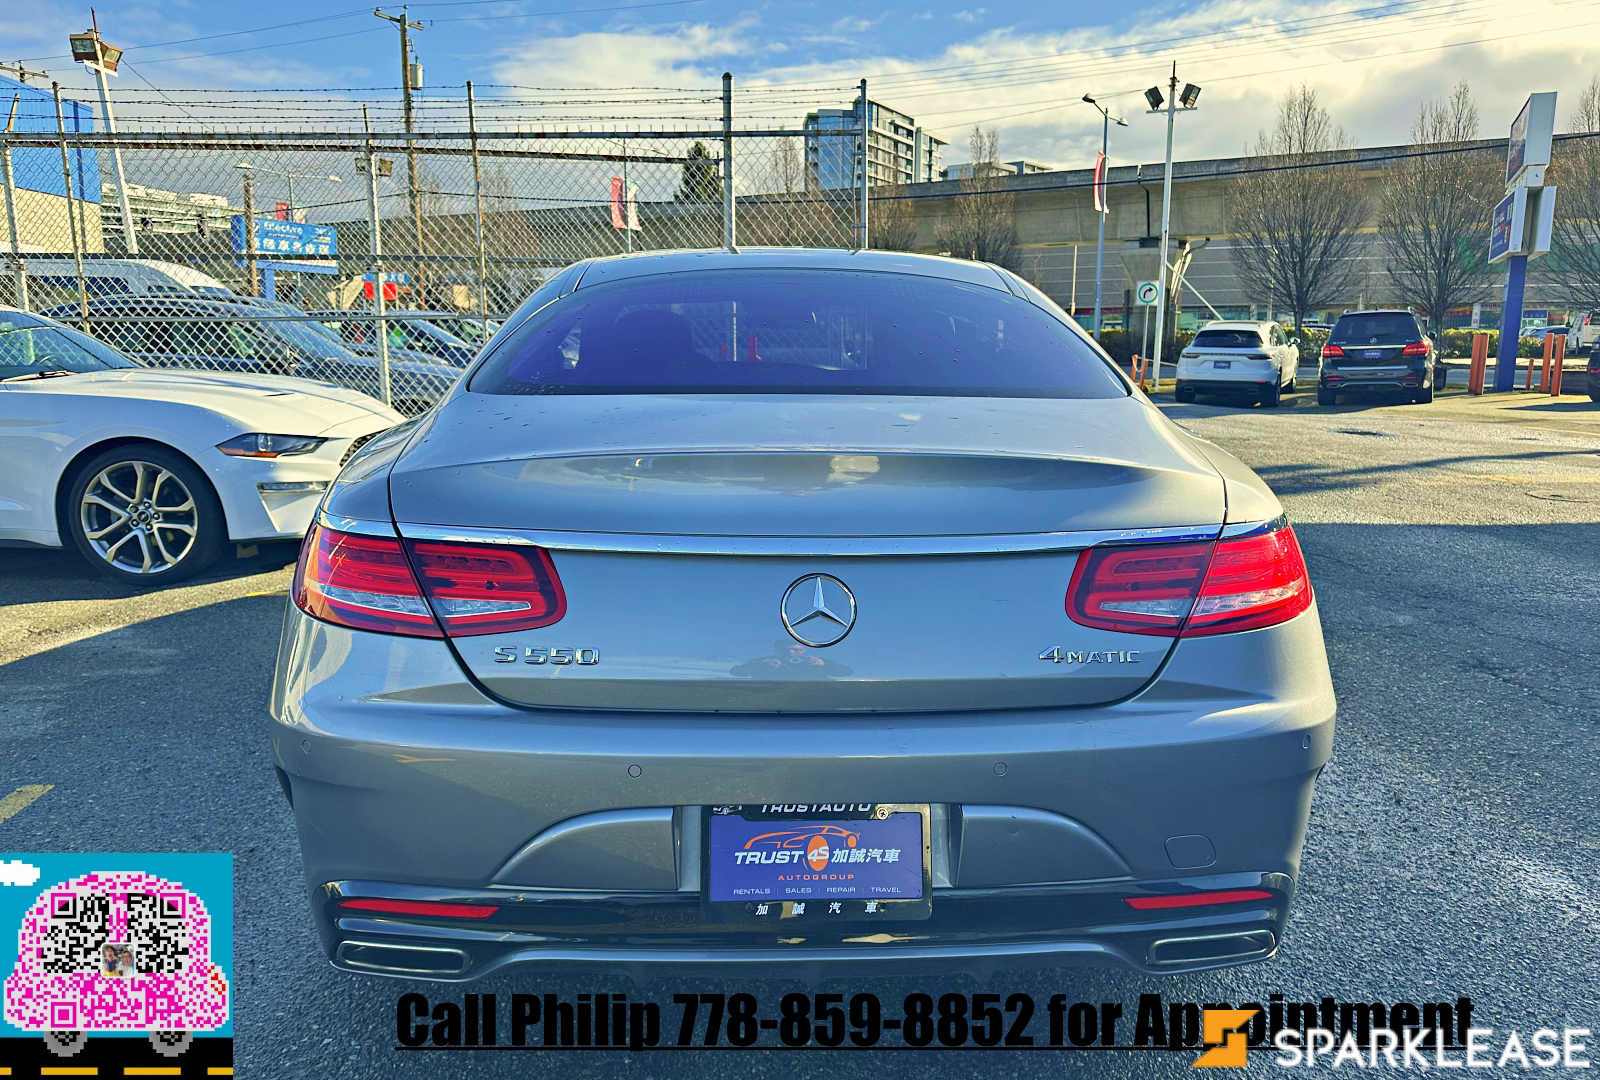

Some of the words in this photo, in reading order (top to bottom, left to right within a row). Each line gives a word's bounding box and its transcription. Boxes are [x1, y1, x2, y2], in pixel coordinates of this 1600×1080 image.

[494, 646, 517, 663] S
[525, 647, 600, 665] 550
[1039, 645, 1142, 664] 4MATIC
[734, 851, 805, 865] TRUST
[831, 848, 901, 864] 加誠汽車
[733, 888, 771, 896] RENTALS
